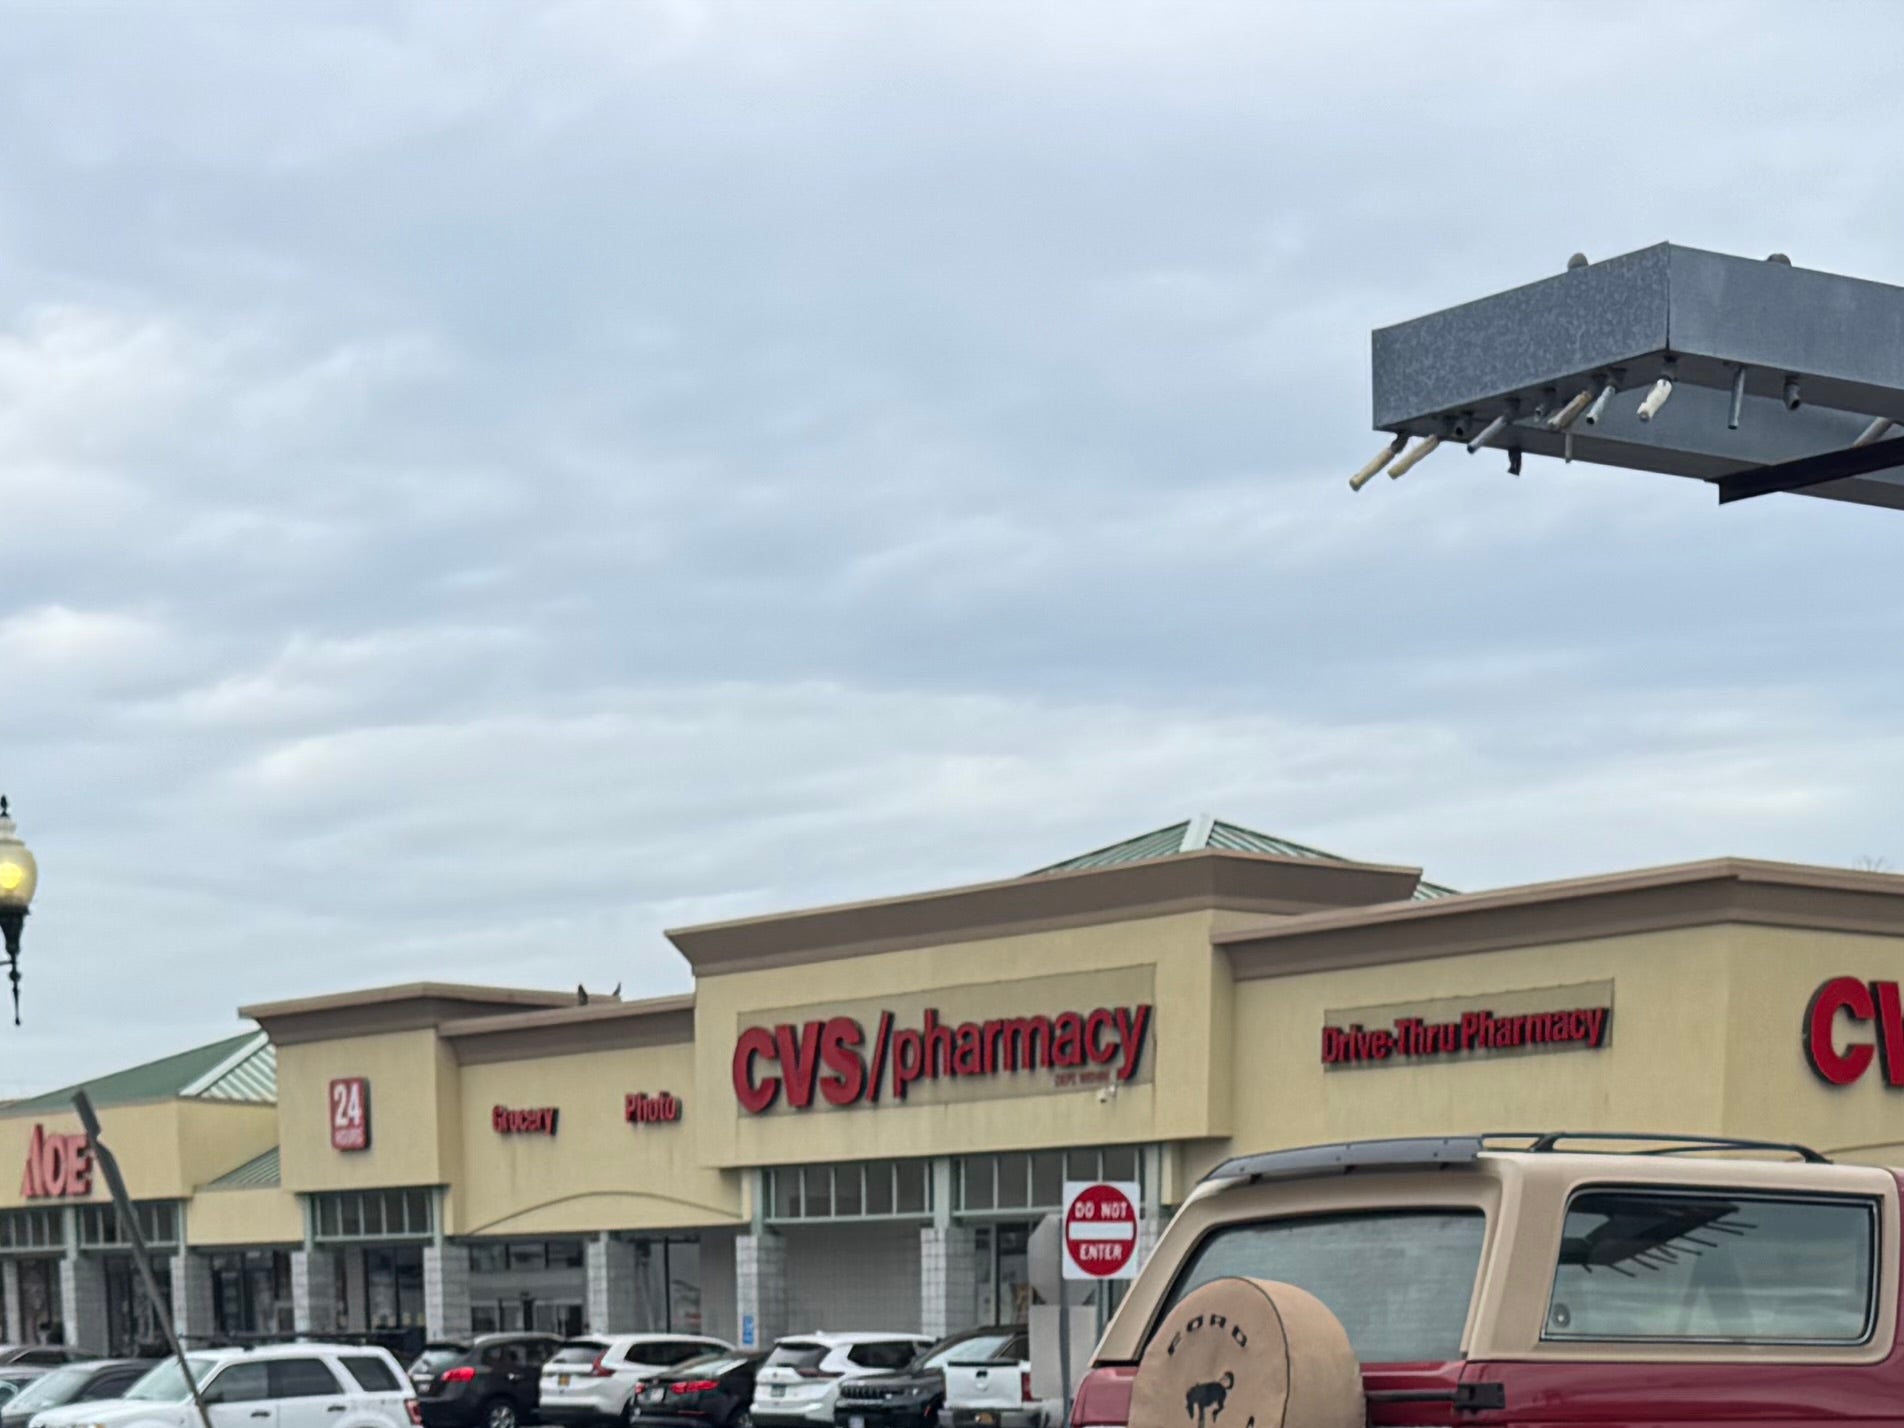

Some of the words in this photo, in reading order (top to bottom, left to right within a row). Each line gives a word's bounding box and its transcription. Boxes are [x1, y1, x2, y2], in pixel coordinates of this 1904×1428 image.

[1321, 1017, 1456, 1065] Drive-Thru
[1460, 1006, 1610, 1050] Pharmacy
[731, 1003, 1152, 1114] CVS/pharmacy
[333, 1083, 362, 1126] 24
[492, 1104, 557, 1136] Grocery
[625, 1091, 680, 1123] Photo
[1074, 1200, 1095, 1219] DO
[1101, 1201, 1128, 1219] NOT
[1079, 1243, 1123, 1261] ENTER
[1167, 1313, 1248, 1357] FORD
